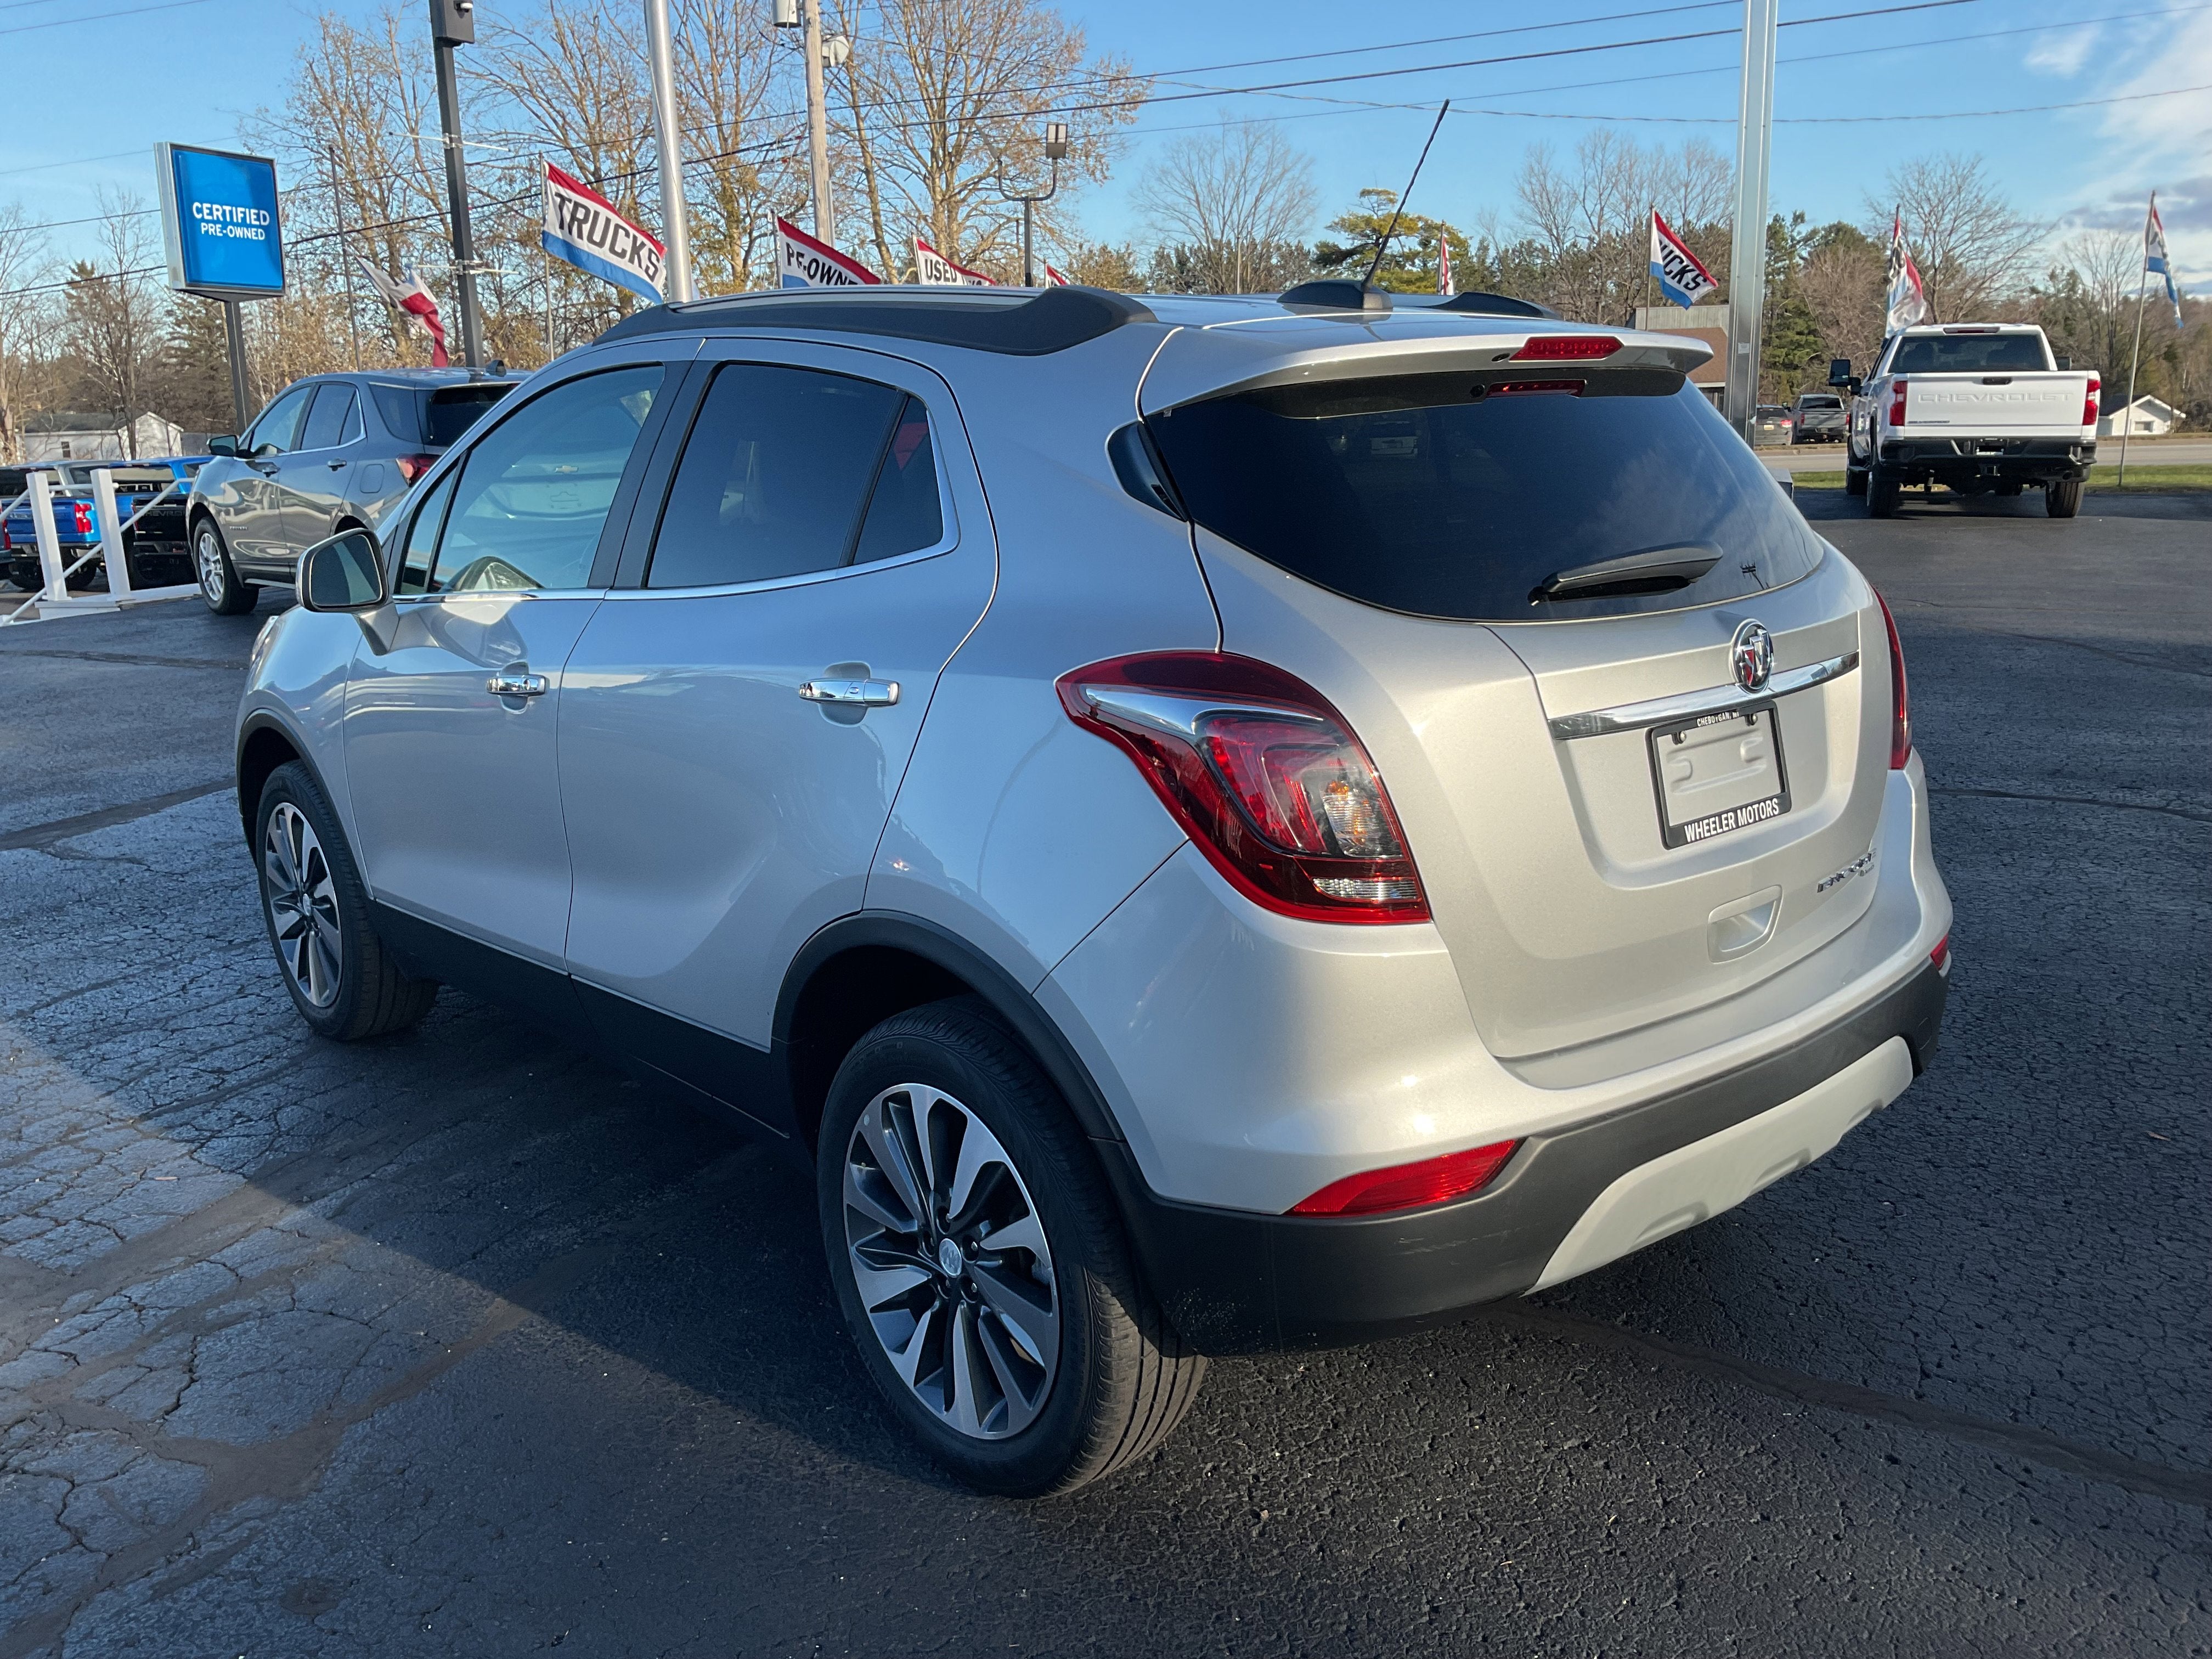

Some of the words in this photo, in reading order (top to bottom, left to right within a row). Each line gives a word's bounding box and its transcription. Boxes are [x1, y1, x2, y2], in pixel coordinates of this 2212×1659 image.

[193, 202, 270, 225] CERTIFIED
[201, 222, 266, 240] PRE-OWNED
[555, 191, 660, 283] TRUCKS
[924, 258, 957, 283] USED
[1918, 392, 2074, 404] CHEVROLET
[1684, 812, 1735, 842] WHEELER
[1737, 798, 1779, 826] MOTORS
